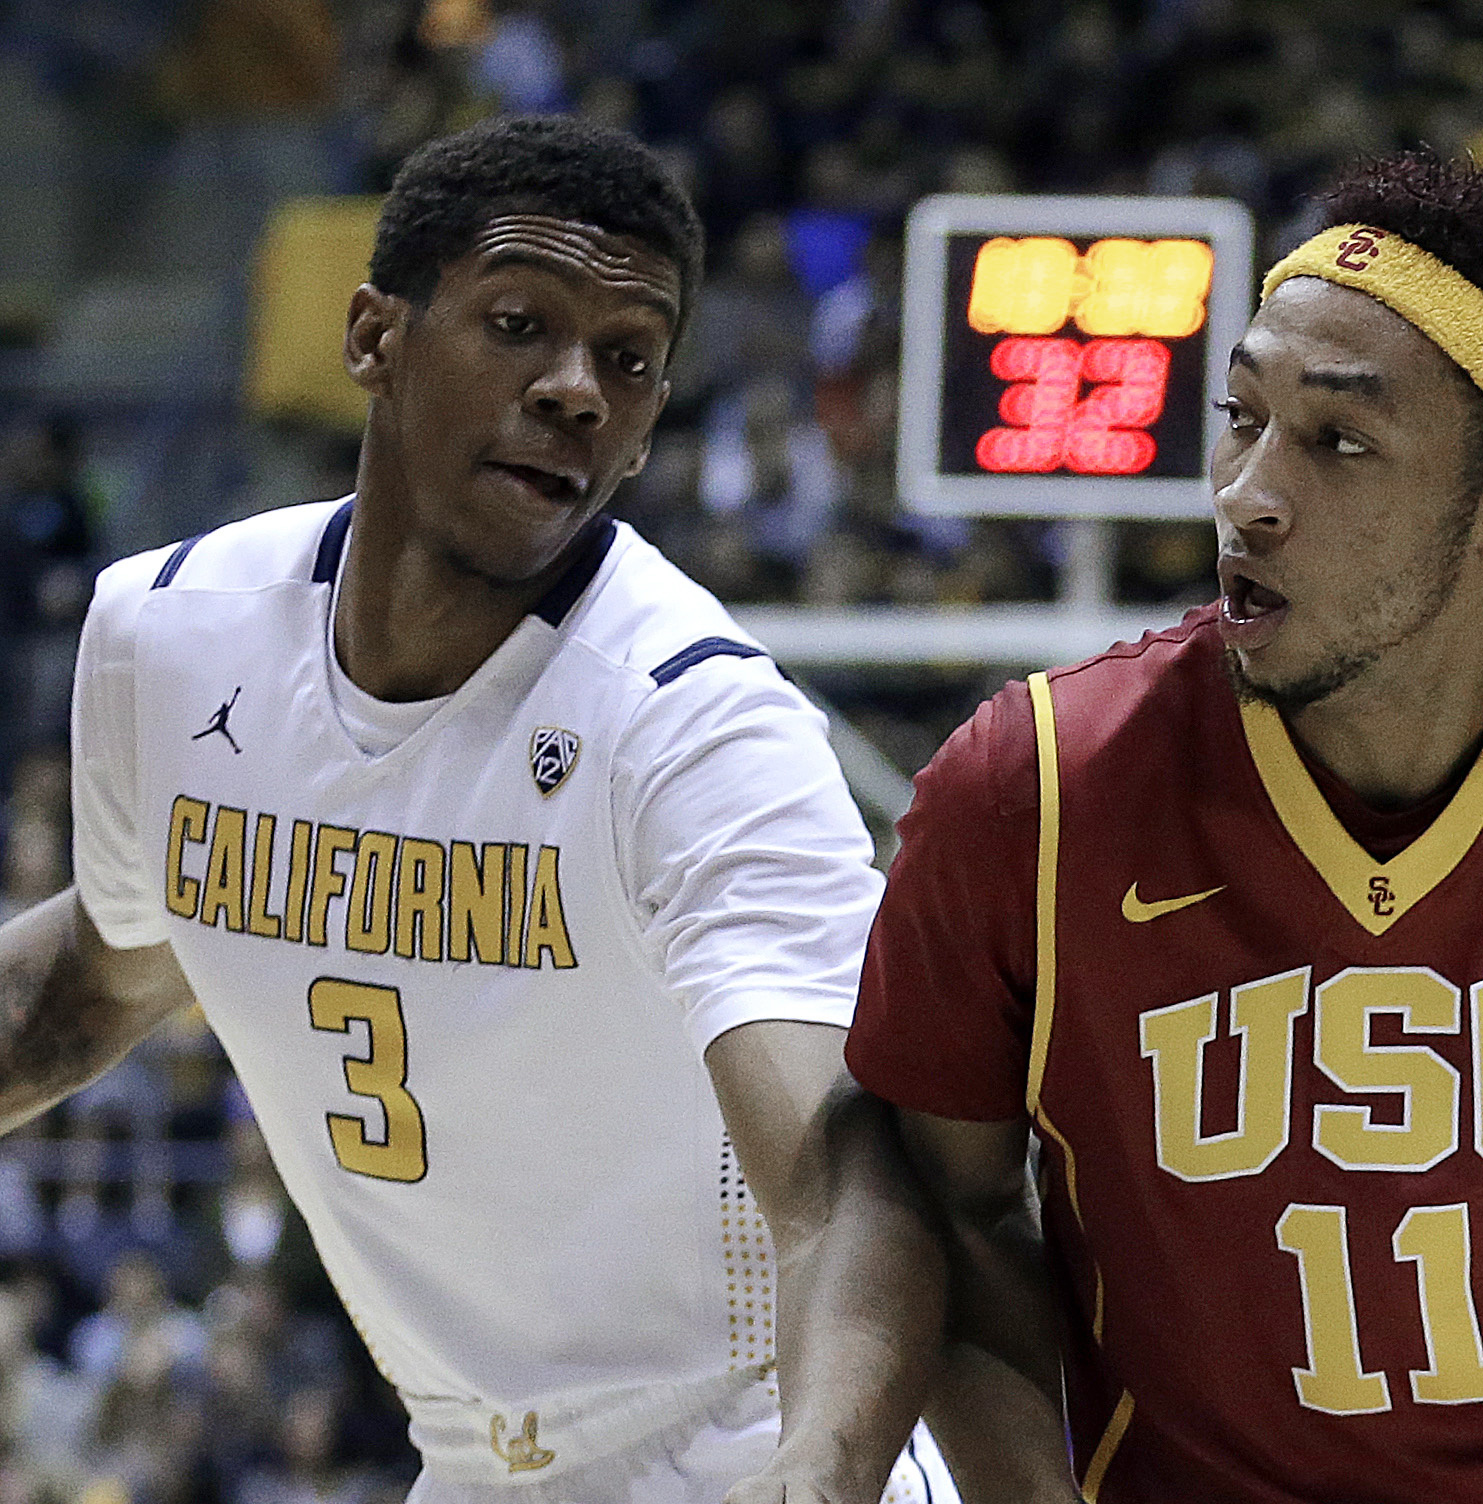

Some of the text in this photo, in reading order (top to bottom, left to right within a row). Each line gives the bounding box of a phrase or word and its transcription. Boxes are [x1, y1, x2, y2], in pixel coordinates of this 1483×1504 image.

[975, 336, 1172, 475] 32
[536, 756, 562, 784] 12
[165, 794, 579, 971] CALIFORNIA
[307, 976, 429, 1184] 3
